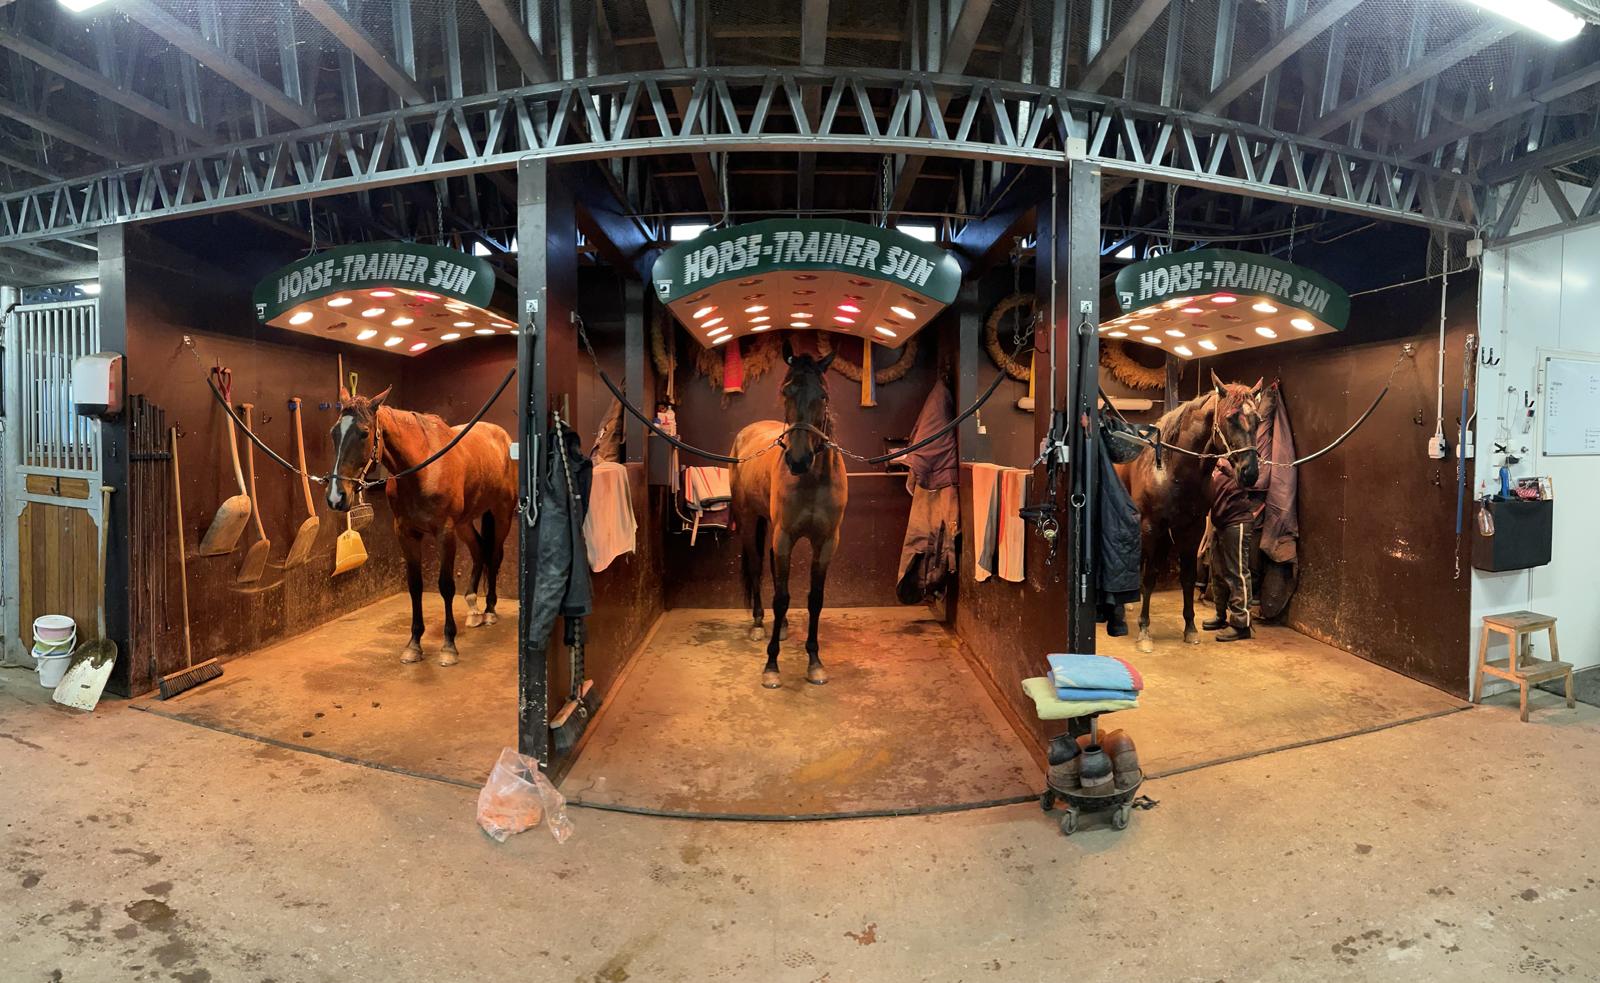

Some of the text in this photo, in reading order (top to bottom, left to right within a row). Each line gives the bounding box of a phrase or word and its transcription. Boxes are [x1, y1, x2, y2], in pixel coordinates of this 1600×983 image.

[277, 253, 477, 303] HORSE-TRAINER SUN
[683, 231, 936, 287] HORSE-TRAINER SUN
[1139, 260, 1331, 313] HORSE-TRAINER SUN
